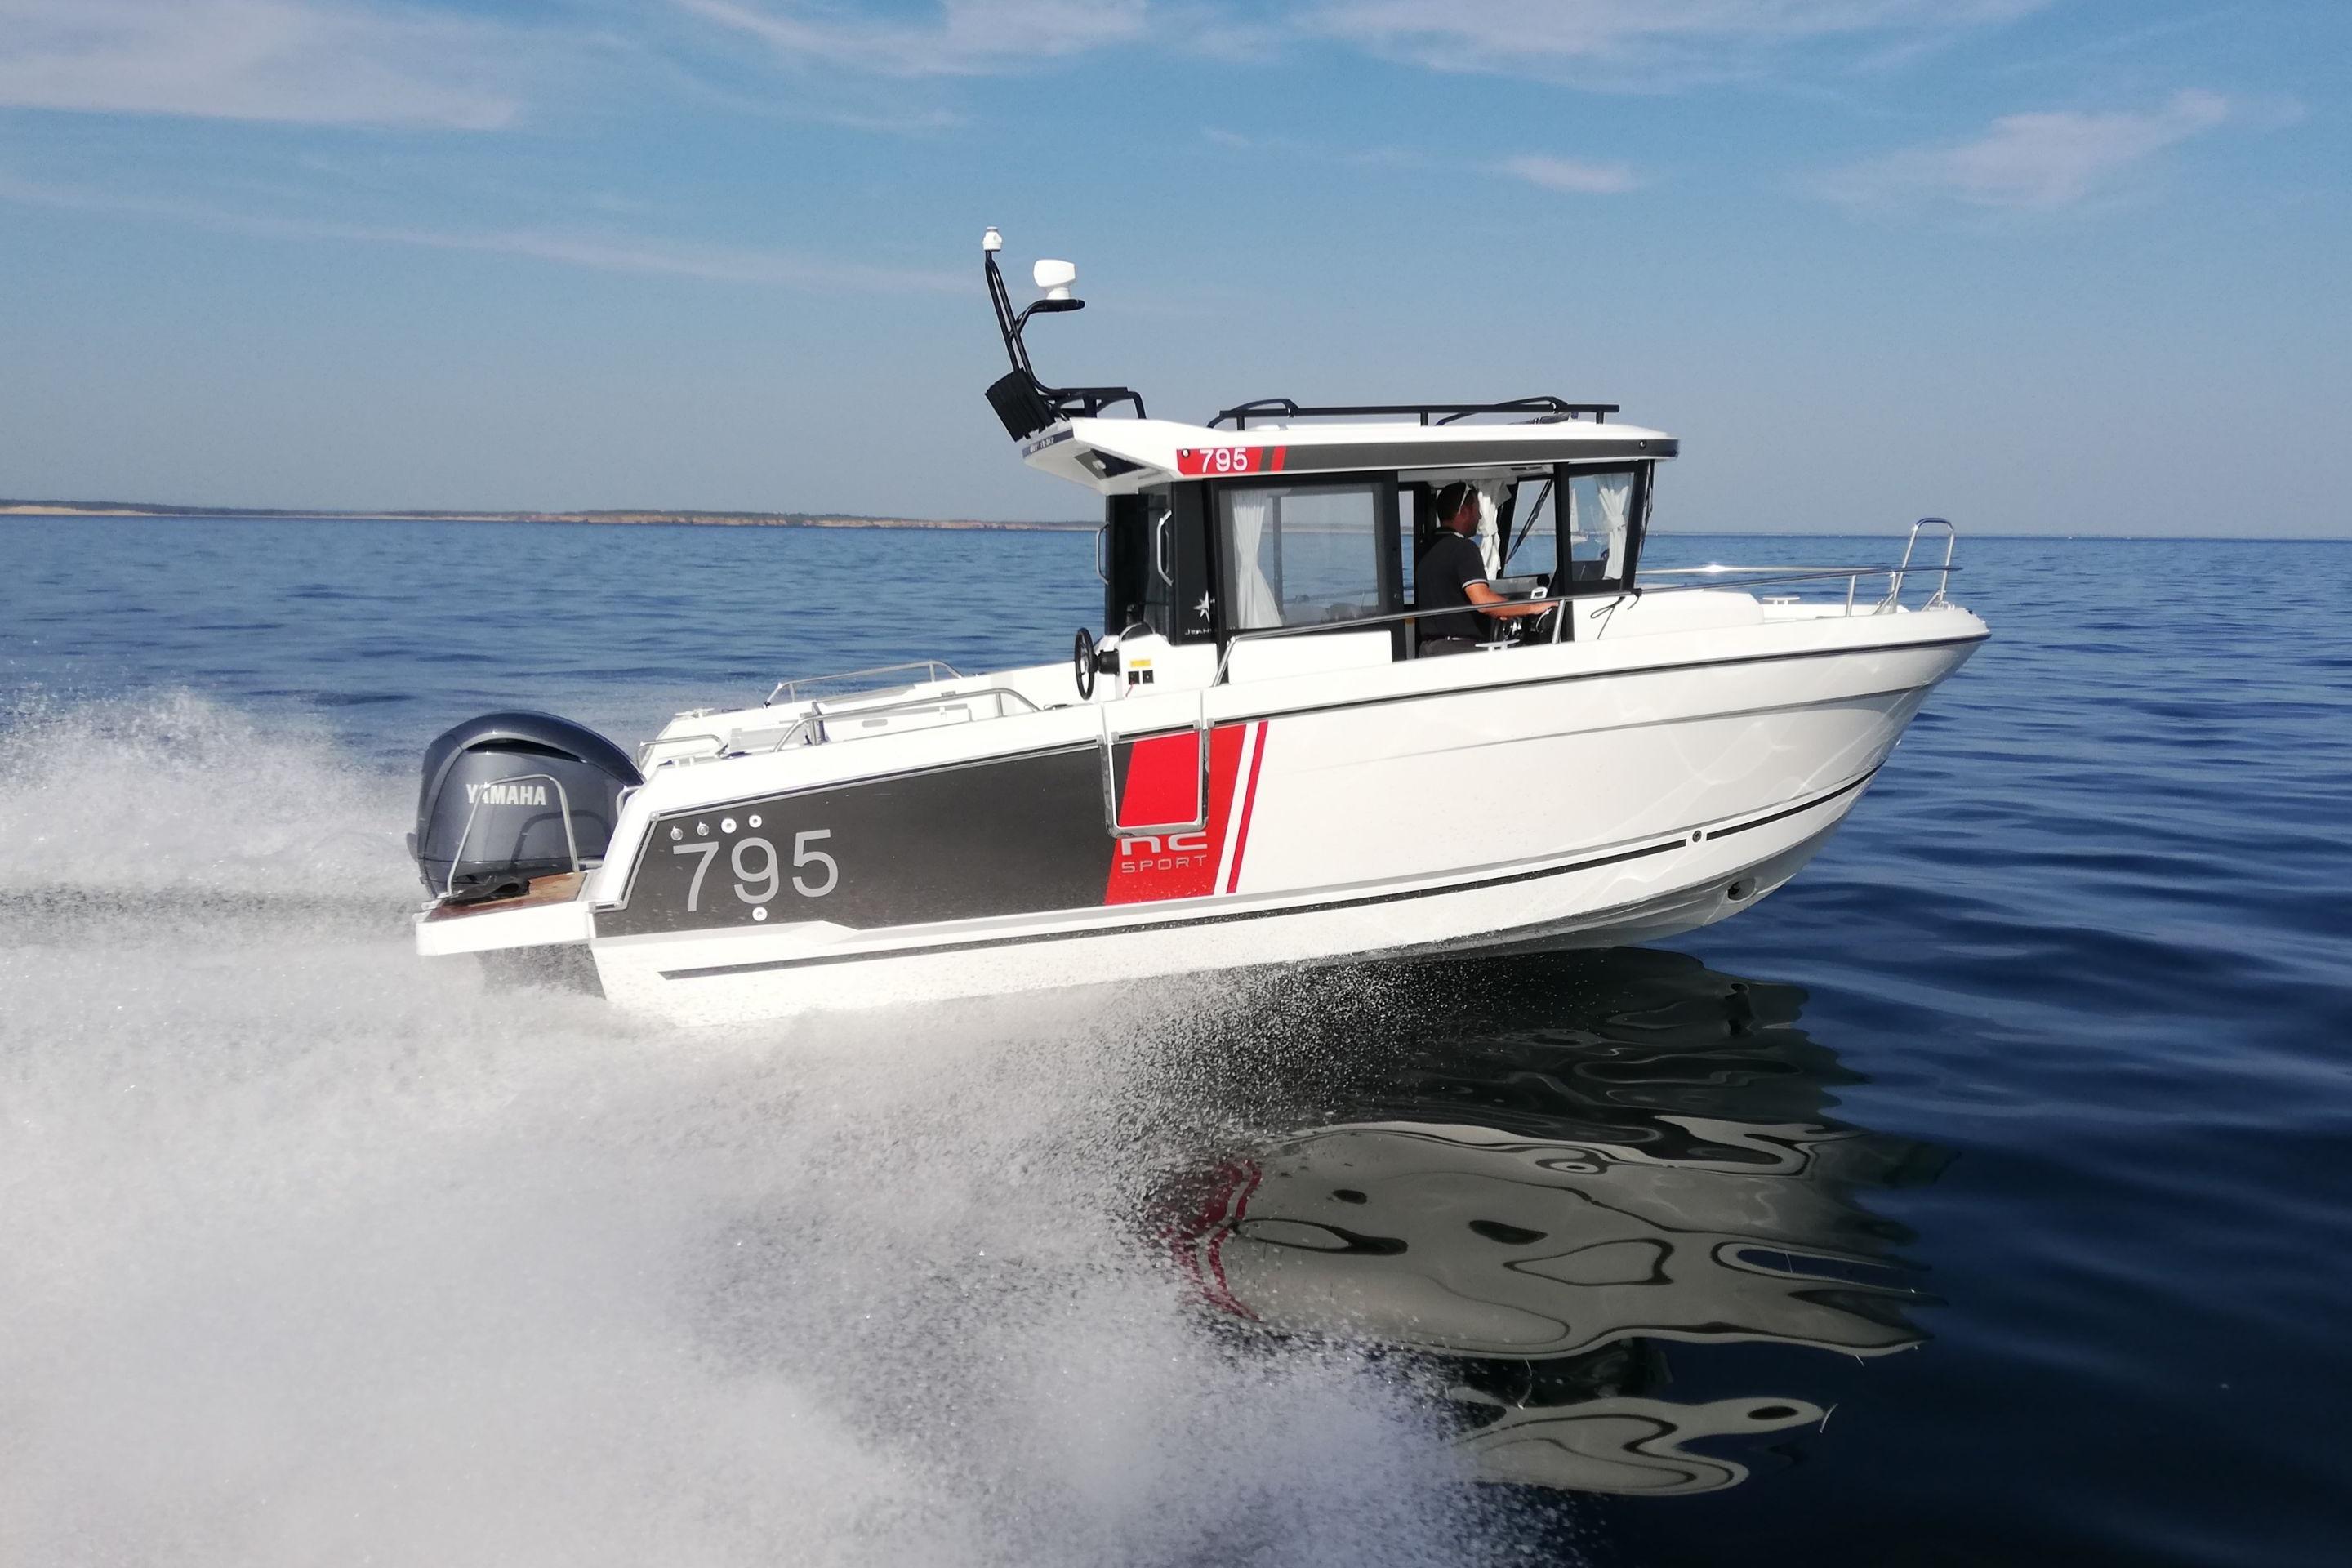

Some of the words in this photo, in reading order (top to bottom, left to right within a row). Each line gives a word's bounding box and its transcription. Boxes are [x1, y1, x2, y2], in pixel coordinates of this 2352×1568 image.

[1199, 448, 1248, 473] 795
[466, 783, 546, 806] YAMAHA
[673, 829, 839, 912] 795
[1121, 854, 1207, 873] SPORT
